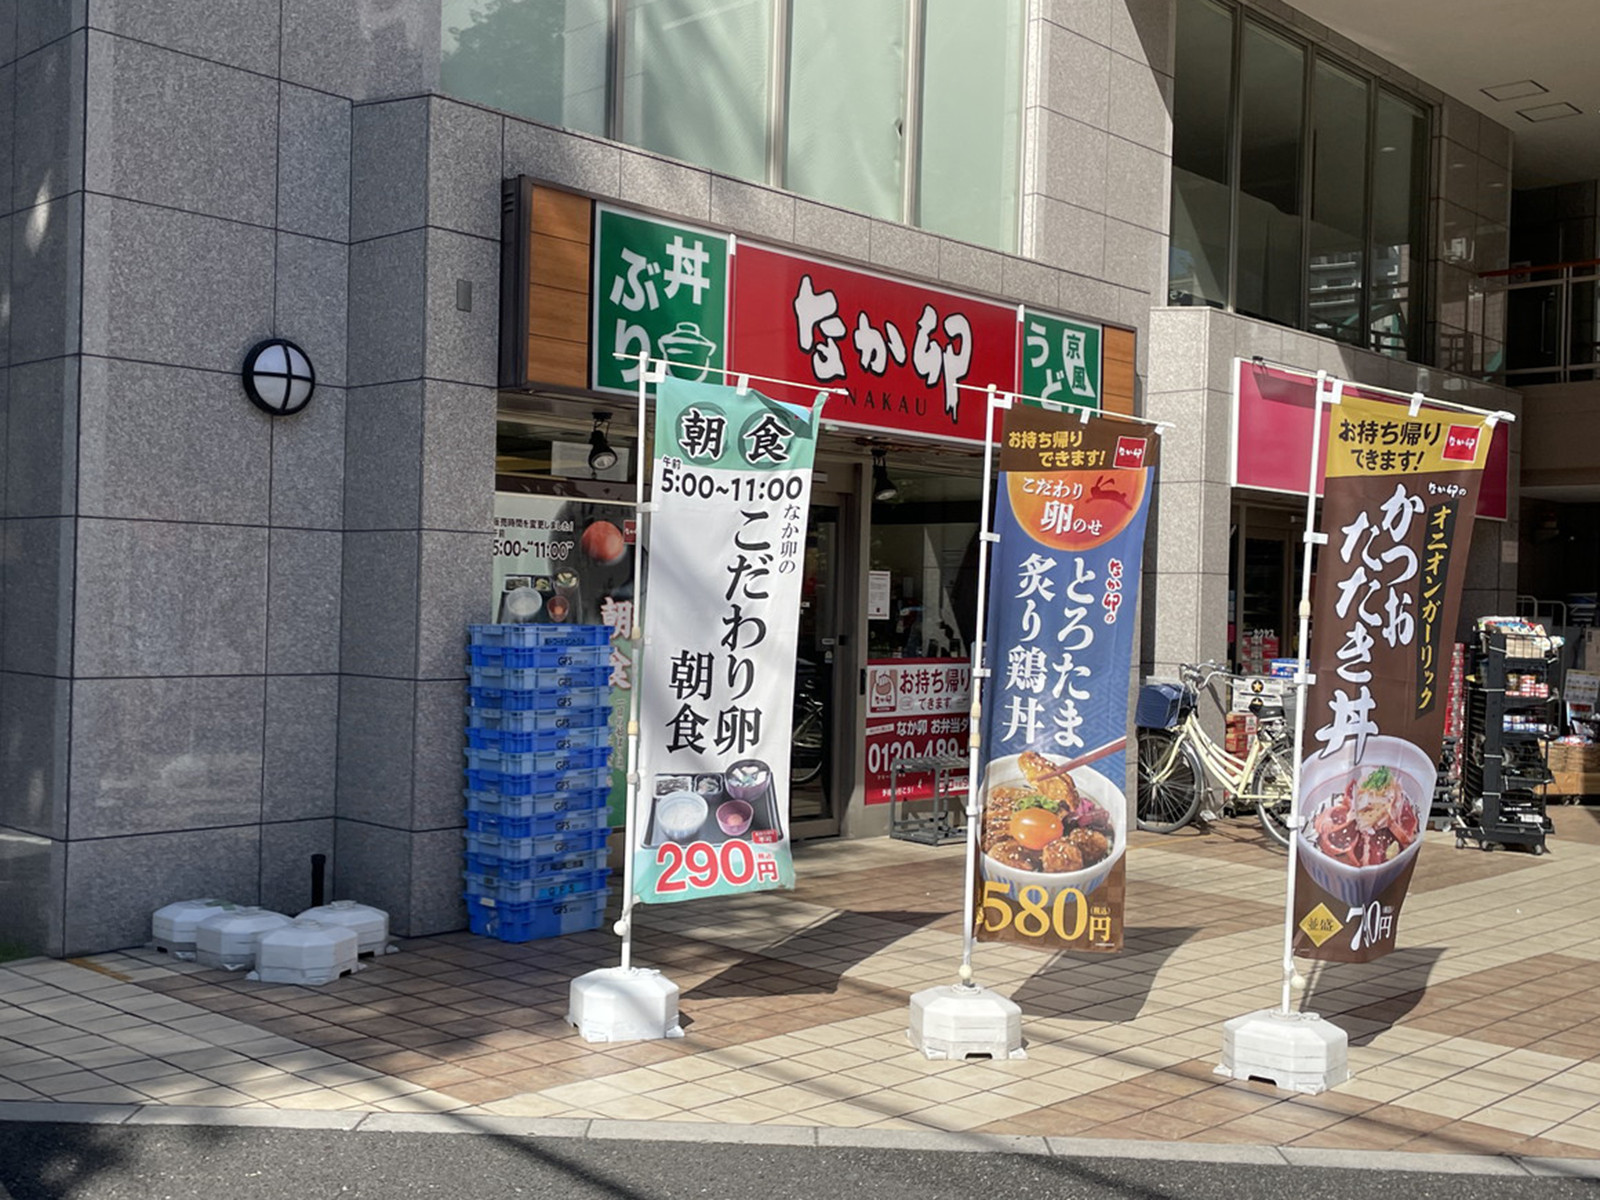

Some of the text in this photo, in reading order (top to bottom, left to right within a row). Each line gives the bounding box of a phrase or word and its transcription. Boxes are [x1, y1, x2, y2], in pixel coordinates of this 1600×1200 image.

[664, 235, 711, 305] 丼
[609, 247, 661, 383] ぶり
[793, 274, 973, 424] なか卯
[1027, 321, 1075, 414] うど
[1066, 334, 1087, 392] 京風
[679, 409, 795, 463] 朝食
[844, 388, 928, 417] NAKAU
[1338, 418, 1443, 447] お持ち帰り
[662, 456, 682, 470] 午前
[1008, 429, 1084, 450] お持ち帰り
[1039, 450, 1107, 468] できます!
[1350, 448, 1425, 472] できます!
[1021, 476, 1084, 500] こだわり
[1040, 500, 1104, 537] 卵のせ
[778, 503, 801, 575] なか卯の
[1379, 483, 1425, 648] かつお
[1102, 558, 1124, 625] なか卯の
[1417, 505, 1453, 710] オニオンガーリック
[713, 508, 774, 756] こだわり卵
[1001, 552, 1058, 745] 炙り鶏丼
[1052, 556, 1096, 748] とろたま
[1314, 511, 1384, 766] たたき丼
[665, 650, 715, 755] 朝食
[899, 668, 971, 695] お持ち帰り
